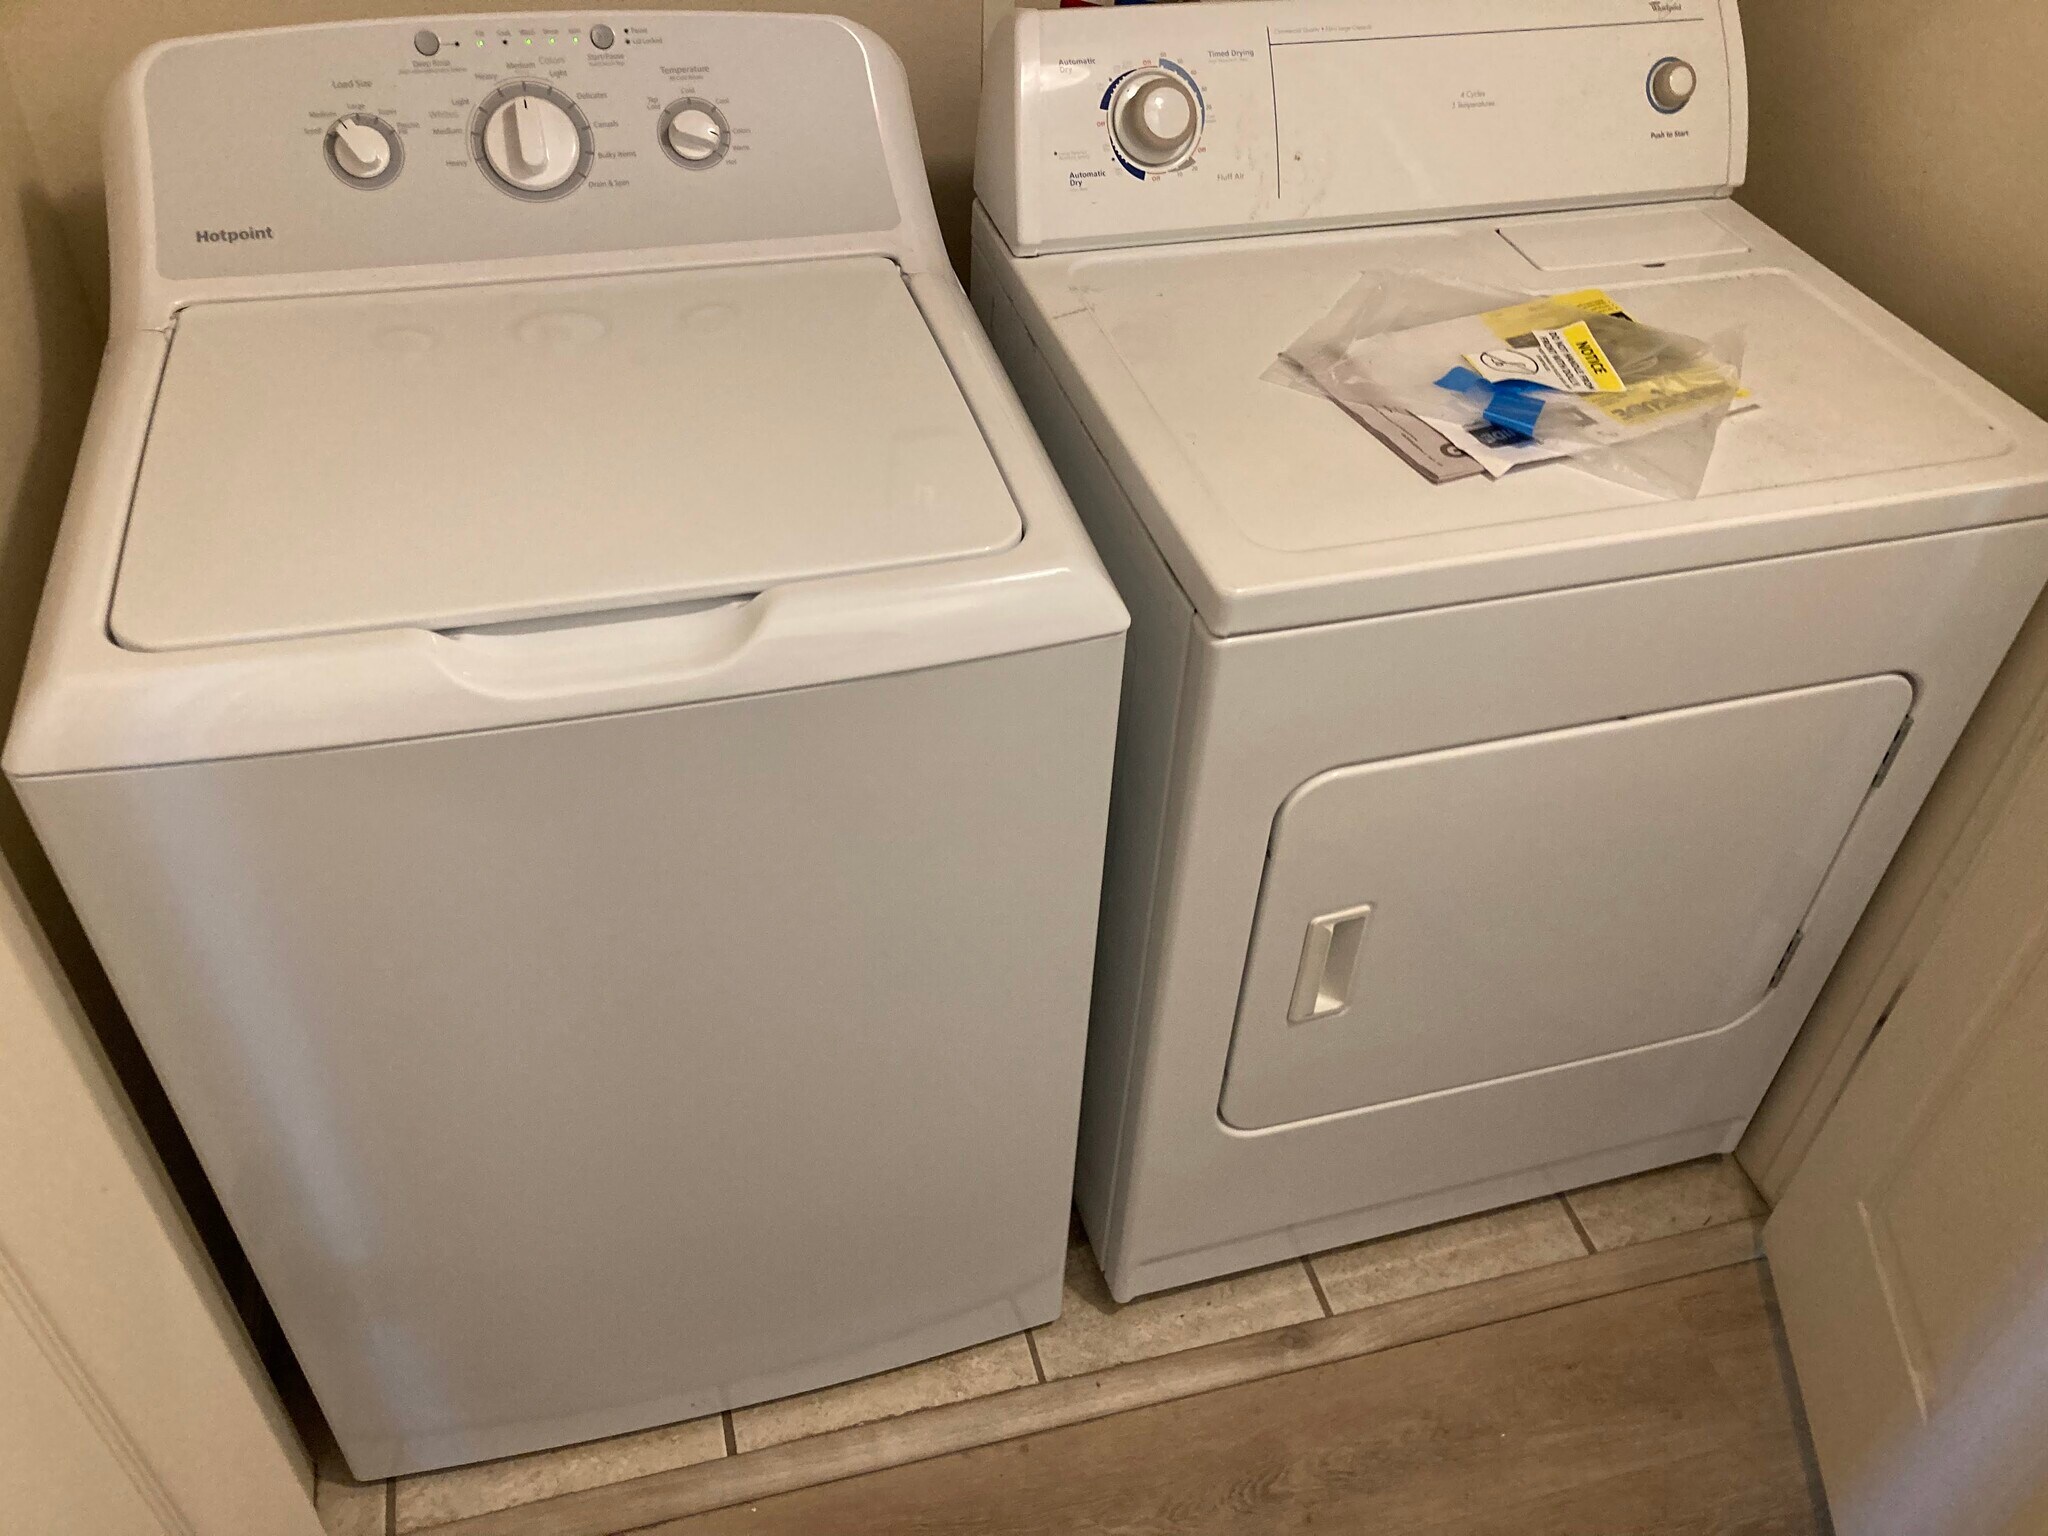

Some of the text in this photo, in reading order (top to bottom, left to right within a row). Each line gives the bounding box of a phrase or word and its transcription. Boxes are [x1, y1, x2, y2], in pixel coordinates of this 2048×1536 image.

[1208, 49, 1255, 58] Timed Drying
[1058, 57, 1096, 66] Automatic
[660, 65, 710, 75] Temperature
[1060, 66, 1073, 75] Dry
[1650, 131, 1665, 139] Push
[1674, 130, 1689, 138] Start
[1069, 169, 1106, 179] Automatic
[1234, 172, 1245, 180] Air
[1069, 180, 1083, 188] Dry
[196, 226, 274, 243] Hotpoint
[1576, 340, 1607, 375] NOTICE
